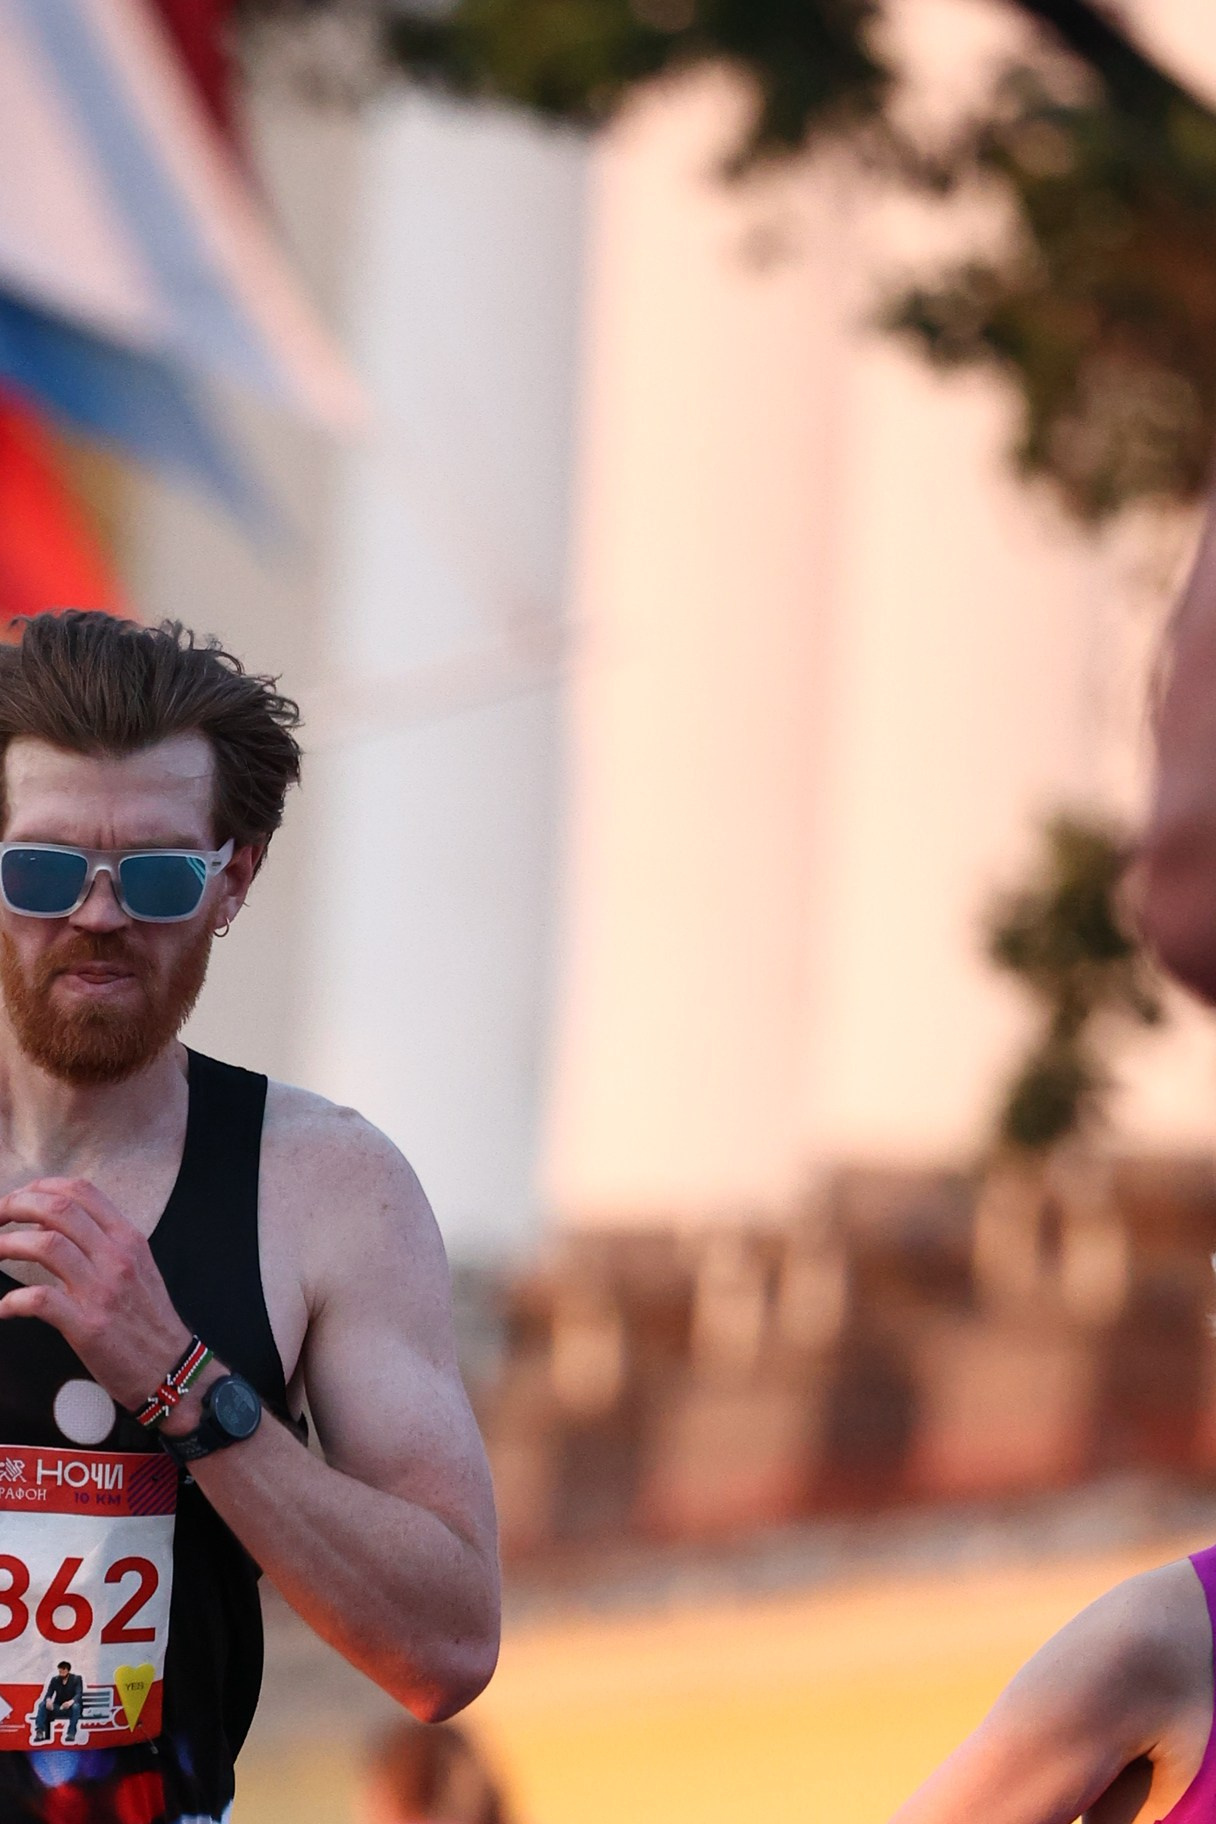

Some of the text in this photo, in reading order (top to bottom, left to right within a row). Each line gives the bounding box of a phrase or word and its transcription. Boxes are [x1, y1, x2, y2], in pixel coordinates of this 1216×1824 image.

[36, 1459, 123, 1490] НОЧИ
[74, 1492, 90, 1504] 10
[124, 1681, 144, 1691] YES
